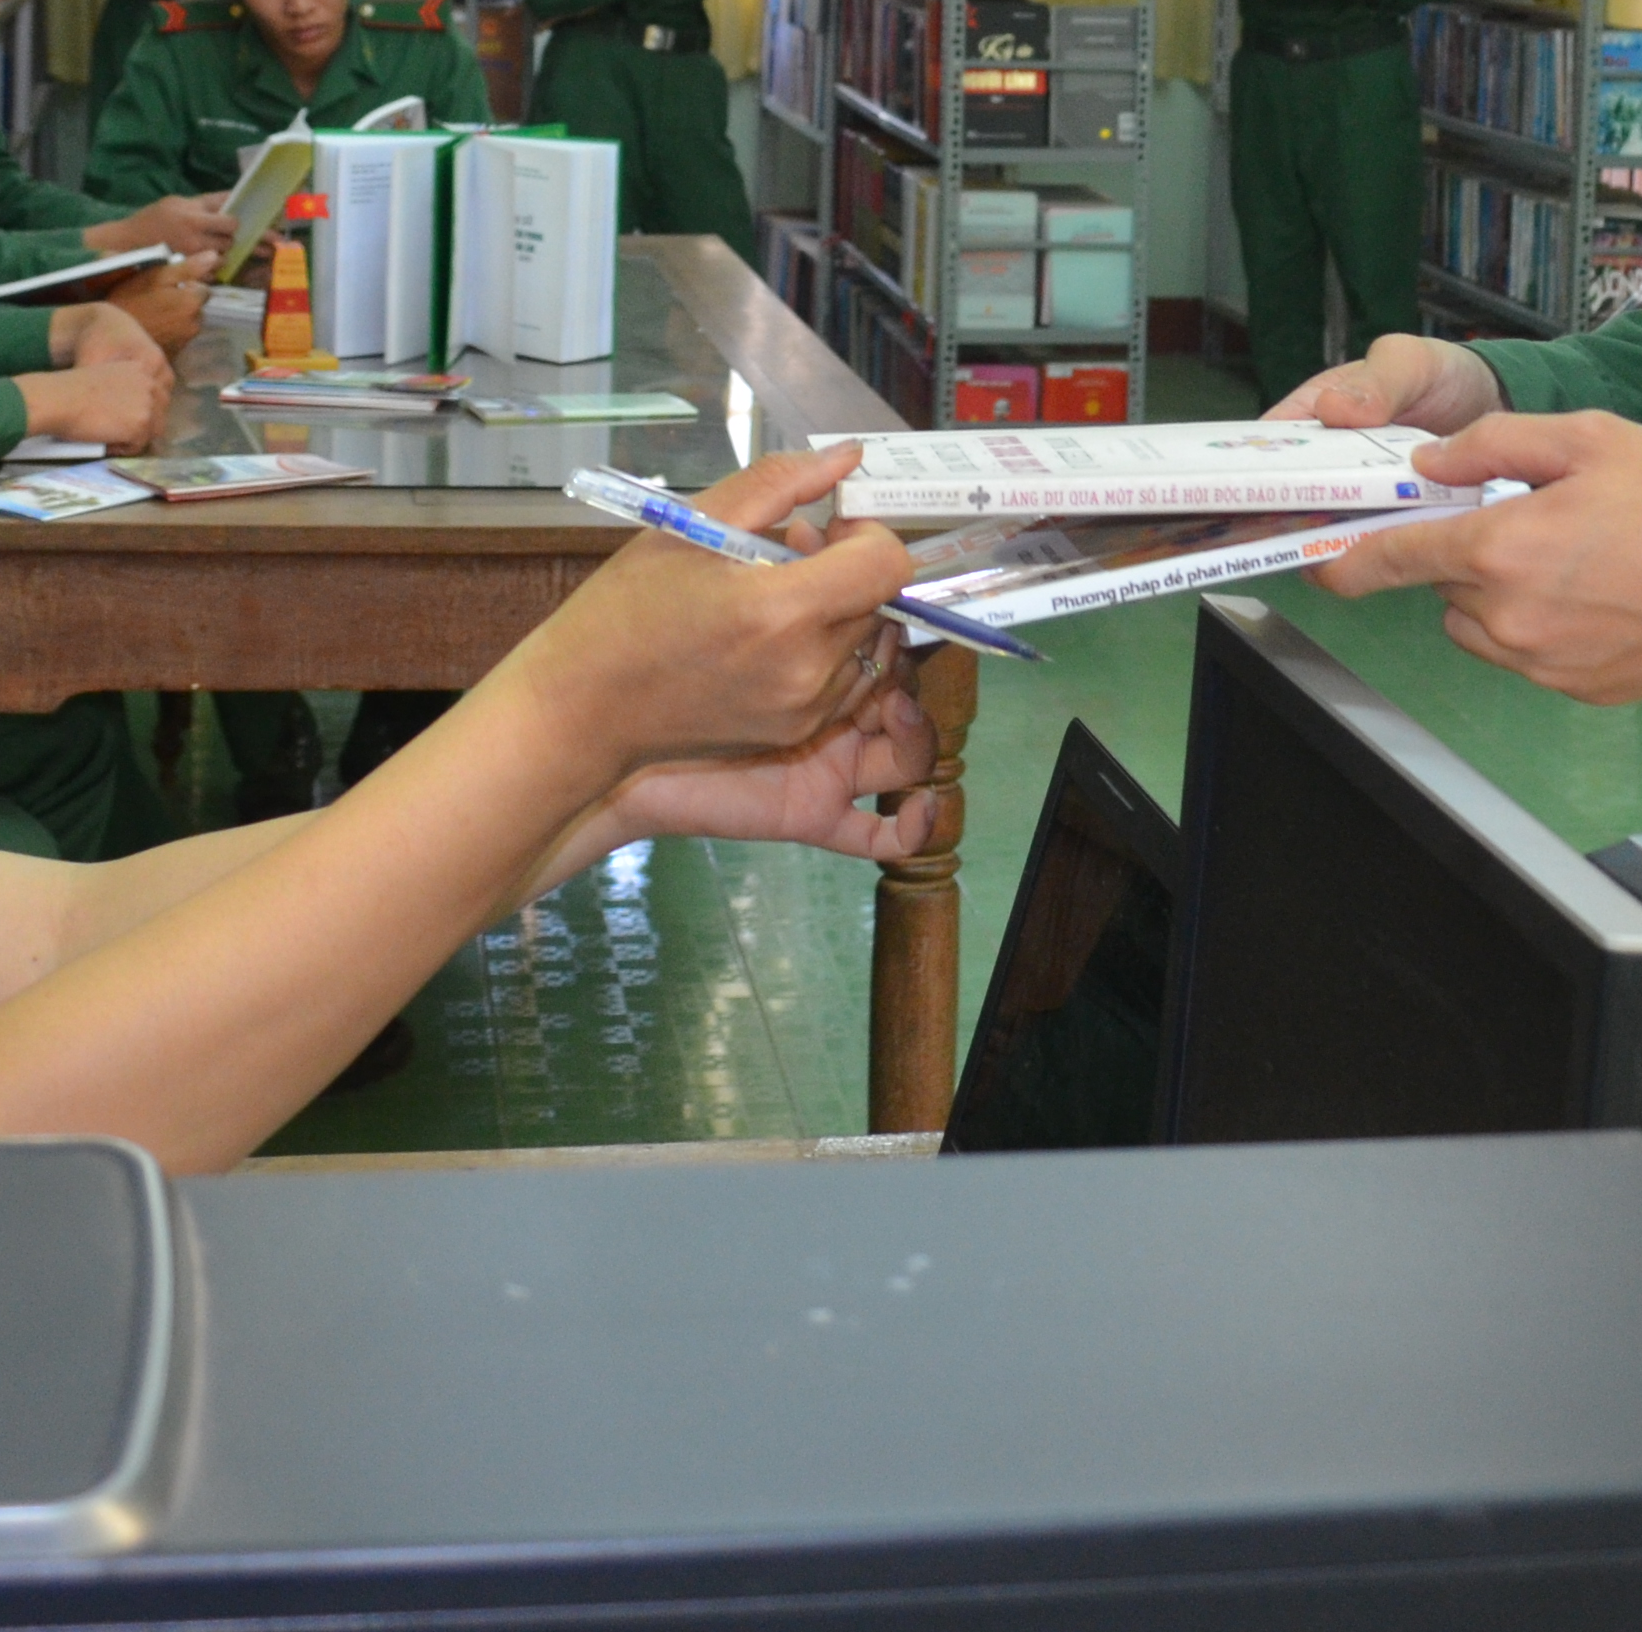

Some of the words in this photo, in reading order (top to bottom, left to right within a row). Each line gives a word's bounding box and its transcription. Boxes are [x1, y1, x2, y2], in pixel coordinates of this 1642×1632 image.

[1044, 490, 1064, 506] DU
[1069, 490, 1100, 506] QUA
[1294, 483, 1327, 503] VIỆT
[1330, 485, 1361, 501] NAM
[1119, 578, 1161, 603] pháp
[1163, 568, 1185, 587] để
[1187, 564, 1223, 588] phát
[1225, 557, 1262, 575] hiện
[1264, 547, 1301, 566] sớm
[1303, 537, 1349, 558] BỆNH
